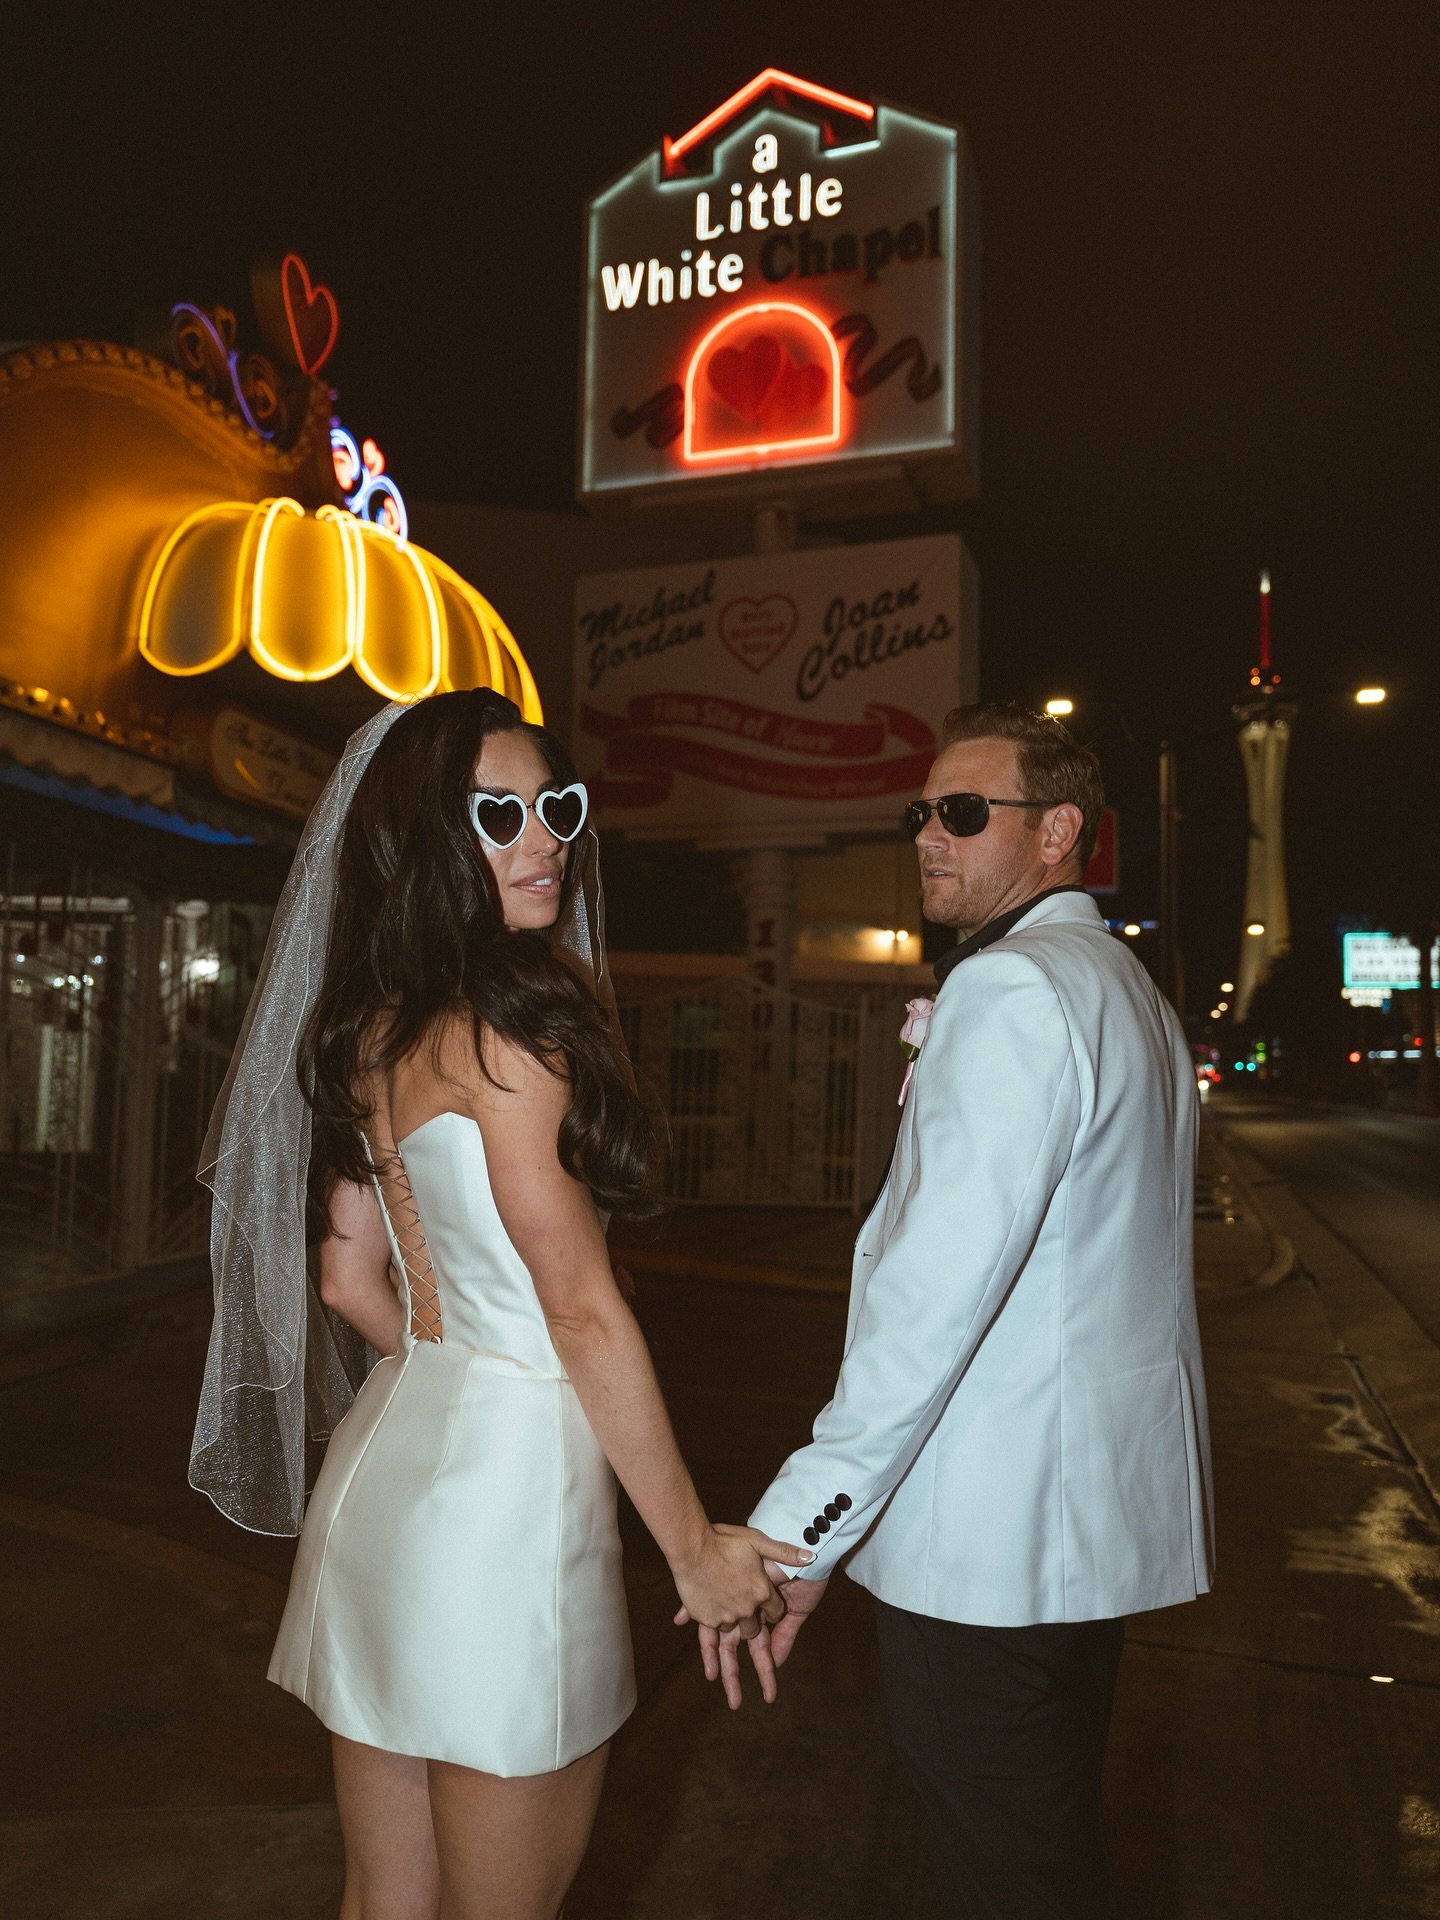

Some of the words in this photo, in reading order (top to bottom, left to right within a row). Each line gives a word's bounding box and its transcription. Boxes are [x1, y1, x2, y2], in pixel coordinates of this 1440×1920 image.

[752, 133, 779, 173] a
[695, 172, 844, 241] Little
[600, 248, 745, 312] White
[759, 205, 942, 286] Chapel
[578, 568, 717, 642] Michael
[822, 579, 921, 655] Joan
[587, 619, 706, 689] Jordan
[796, 613, 954, 702] Collins
